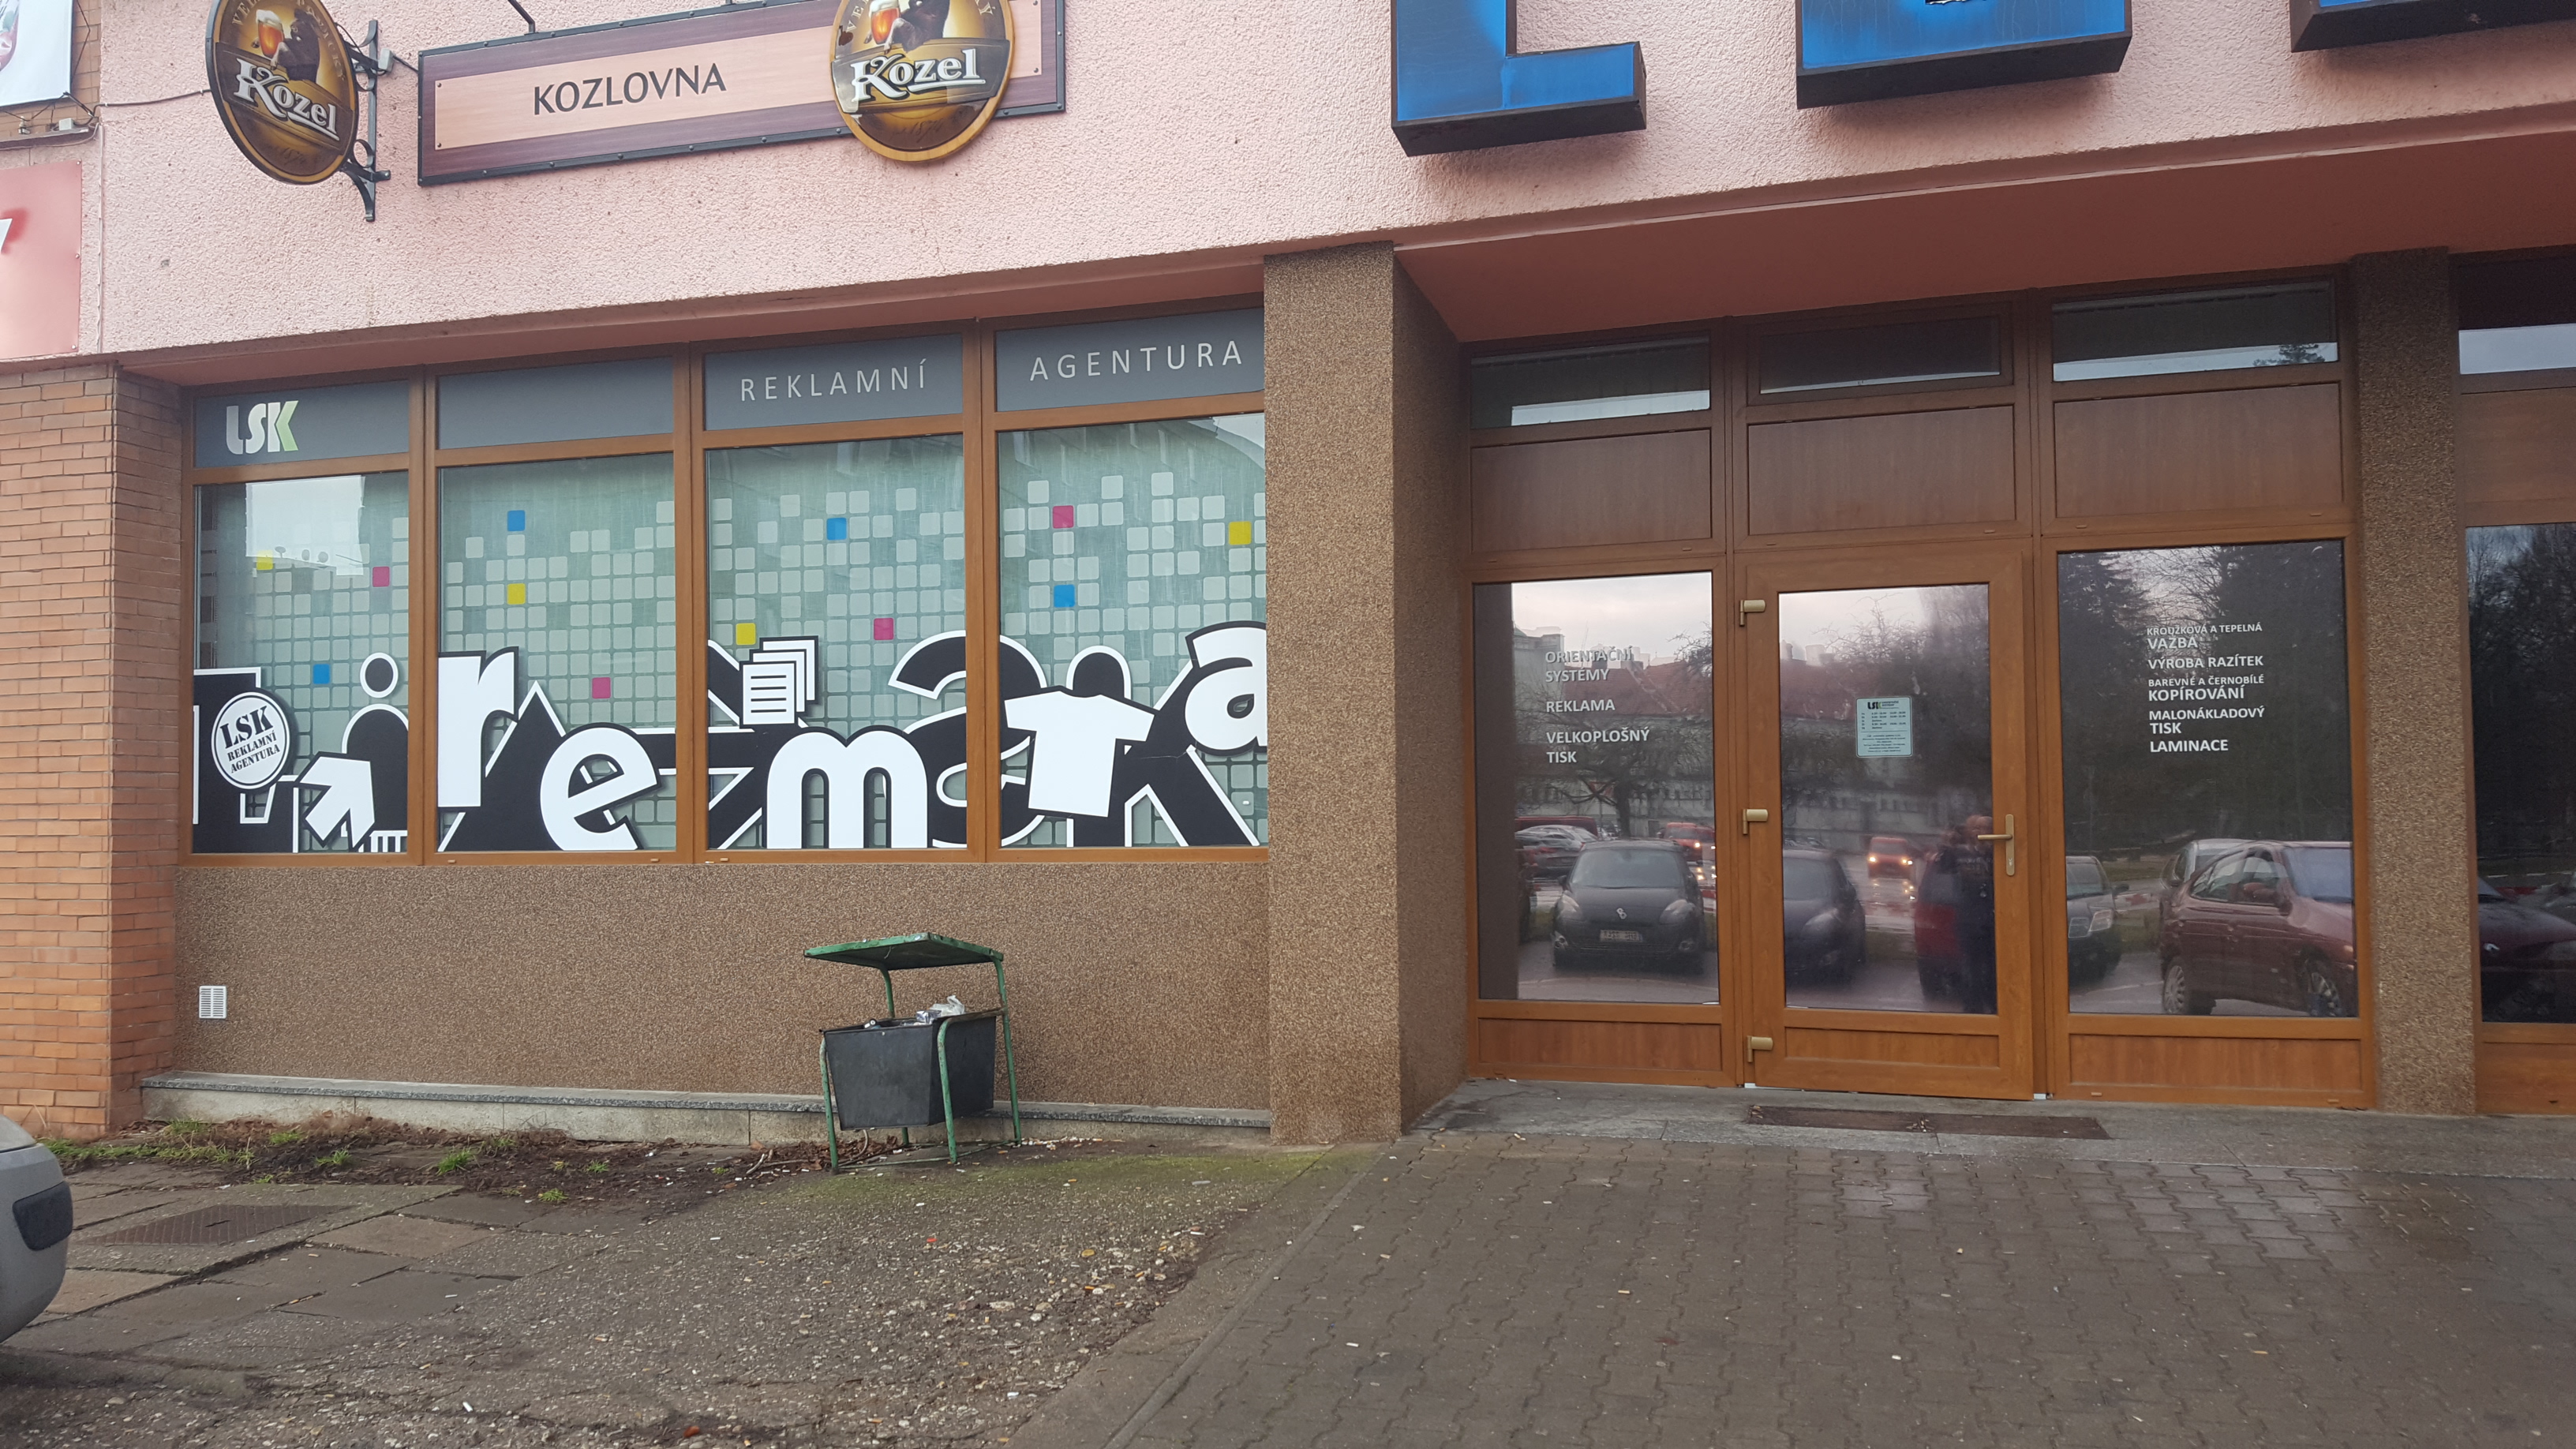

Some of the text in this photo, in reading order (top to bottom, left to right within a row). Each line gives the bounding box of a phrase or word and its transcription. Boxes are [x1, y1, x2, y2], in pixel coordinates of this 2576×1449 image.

[850, 48, 986, 102] Kozel
[533, 62, 726, 115] KOZLOVNA
[234, 58, 339, 140] Kozel
[740, 339, 1242, 402] REKLAMNÍ AGENTURA
[226, 400, 299, 455] LSK
[2210, 623, 2218, 633] A
[2218, 622, 2263, 633] TEPELNÁ
[2147, 636, 2199, 650] VAZBA
[1544, 645, 1634, 664] ORIENTAČNÍ
[2147, 653, 2264, 670] VÝROBA RAZÍTEK
[1544, 667, 1611, 683] SYSTÉMY
[2148, 674, 2265, 687] BAREVNÉ A ČERNOBÍLÉ
[2148, 684, 2245, 702] KOPÍROVÁNÍ
[1546, 698, 1616, 713] REKLAMA
[2148, 705, 2265, 721] MALONÁKLADOVÝ
[219, 705, 274, 749] LSK
[1546, 726, 1650, 743] VELKOPLOŠNÝ
[2149, 722, 2182, 735] TISK
[227, 729, 277, 762] REKLAMNÍ
[2149, 739, 2229, 753] LAMINACE
[230, 743, 281, 773] AGENTURA
[1546, 751, 1578, 764] TISK
